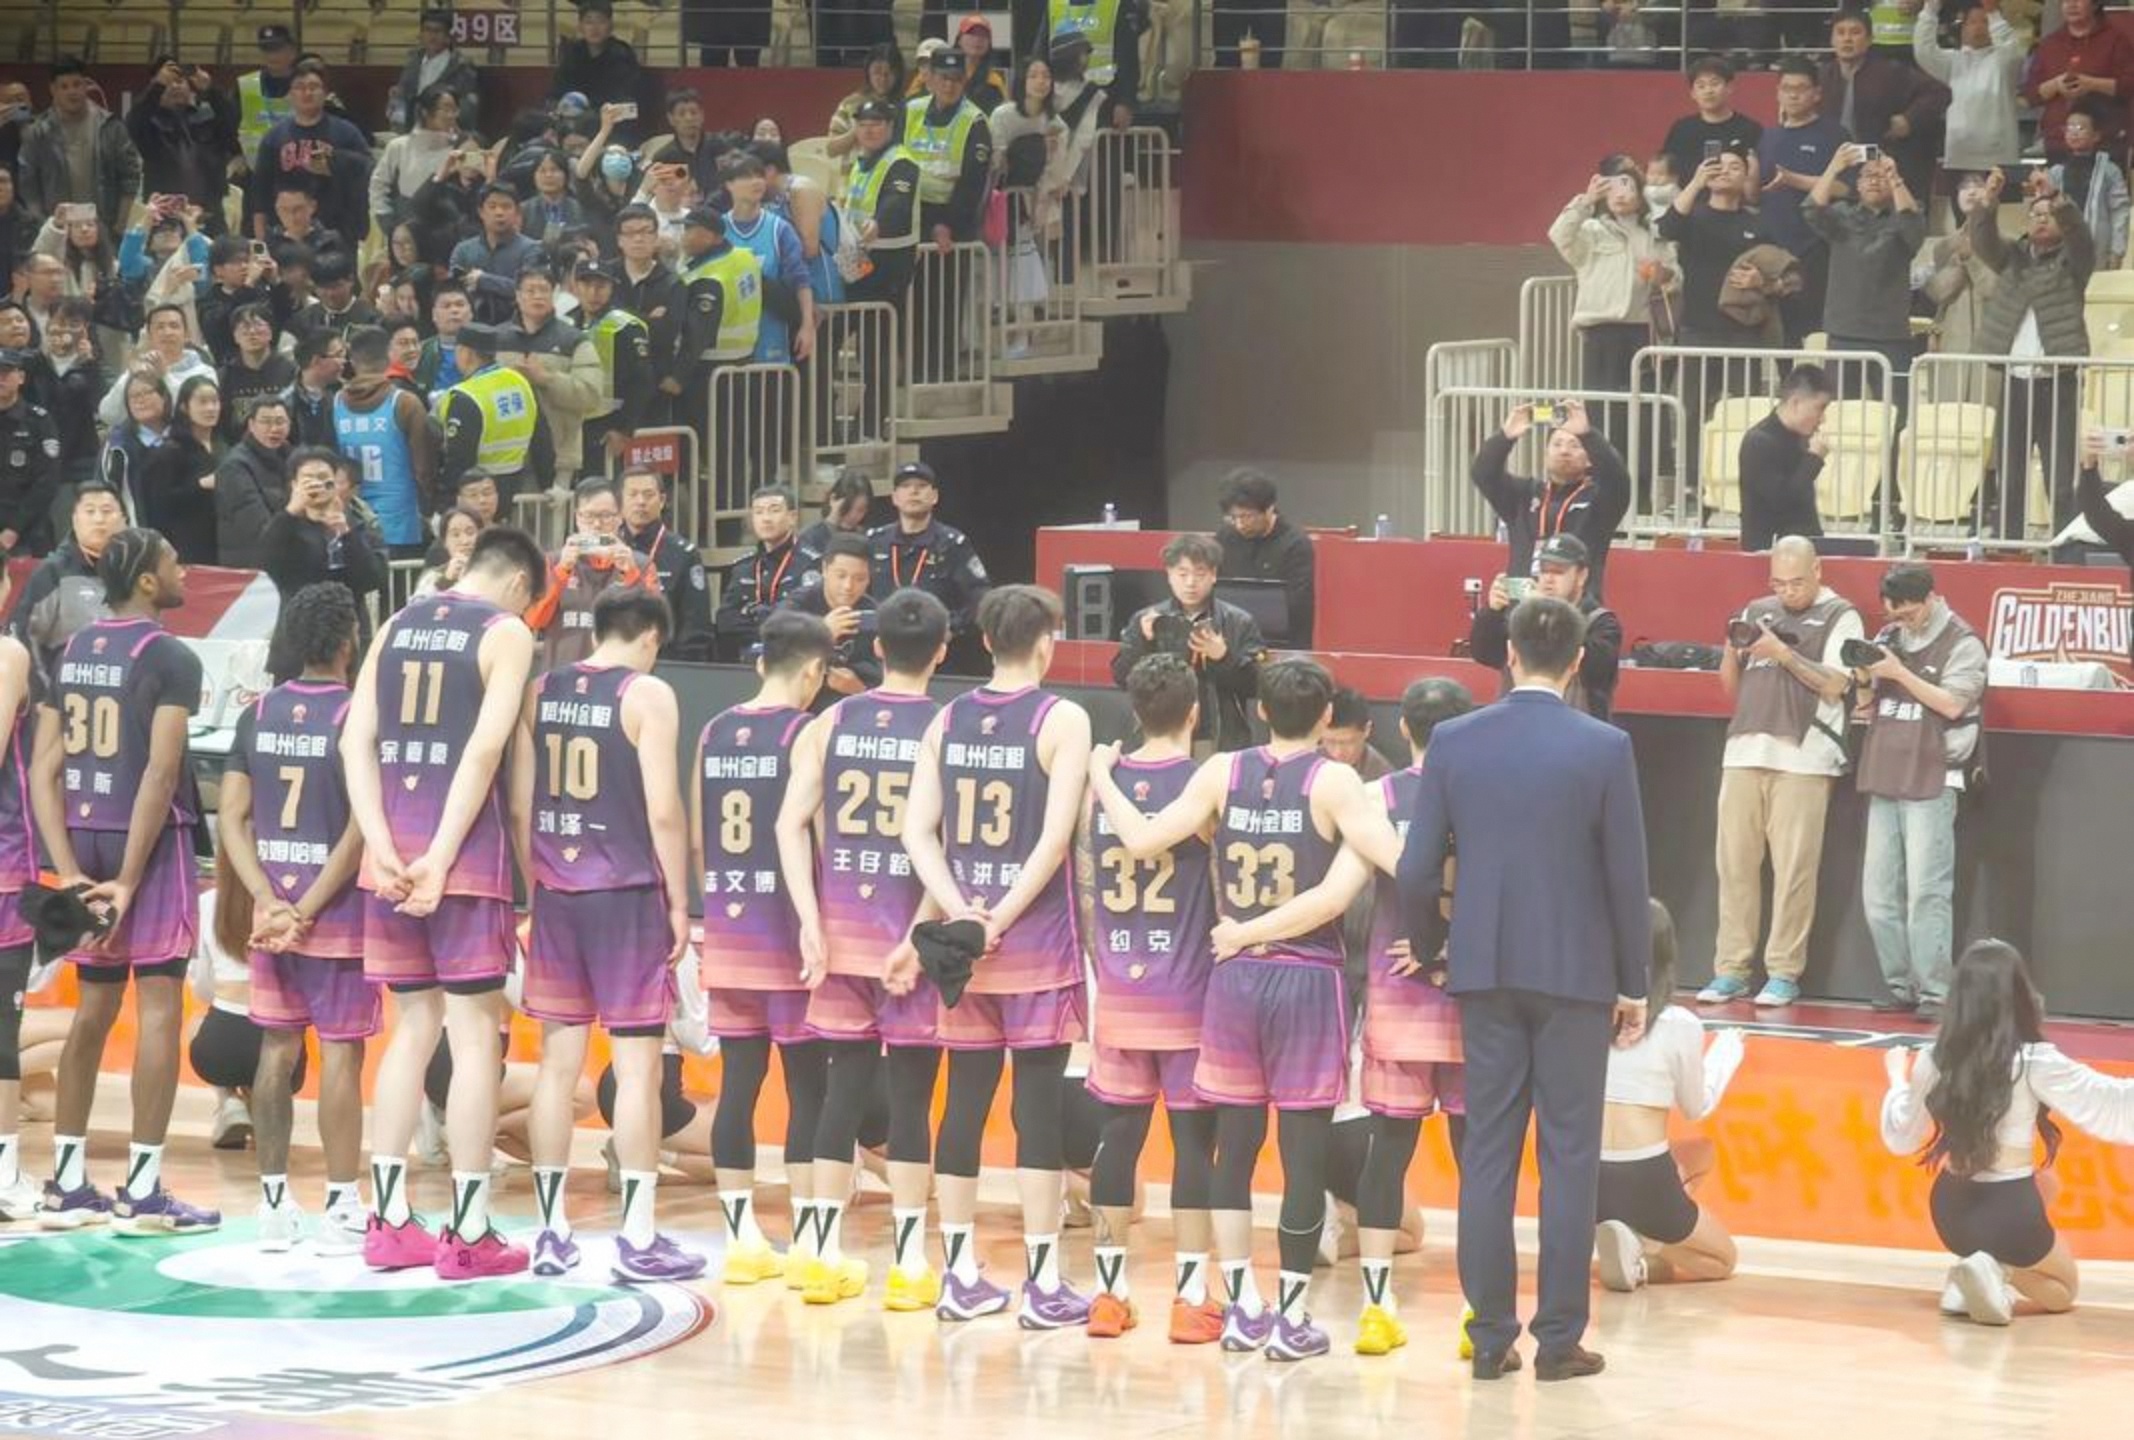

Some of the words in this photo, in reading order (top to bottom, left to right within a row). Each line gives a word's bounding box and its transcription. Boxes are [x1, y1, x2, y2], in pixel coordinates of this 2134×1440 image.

[64, 693, 119, 757] 30
[401, 660, 444, 724] 11
[279, 766, 305, 828] 7
[545, 733, 598, 801] 10
[720, 789, 752, 853] 8
[836, 769, 909, 837] 25
[956, 778, 1013, 846] 13
[1101, 846, 1176, 913] 32
[1226, 841, 1295, 909] 33
